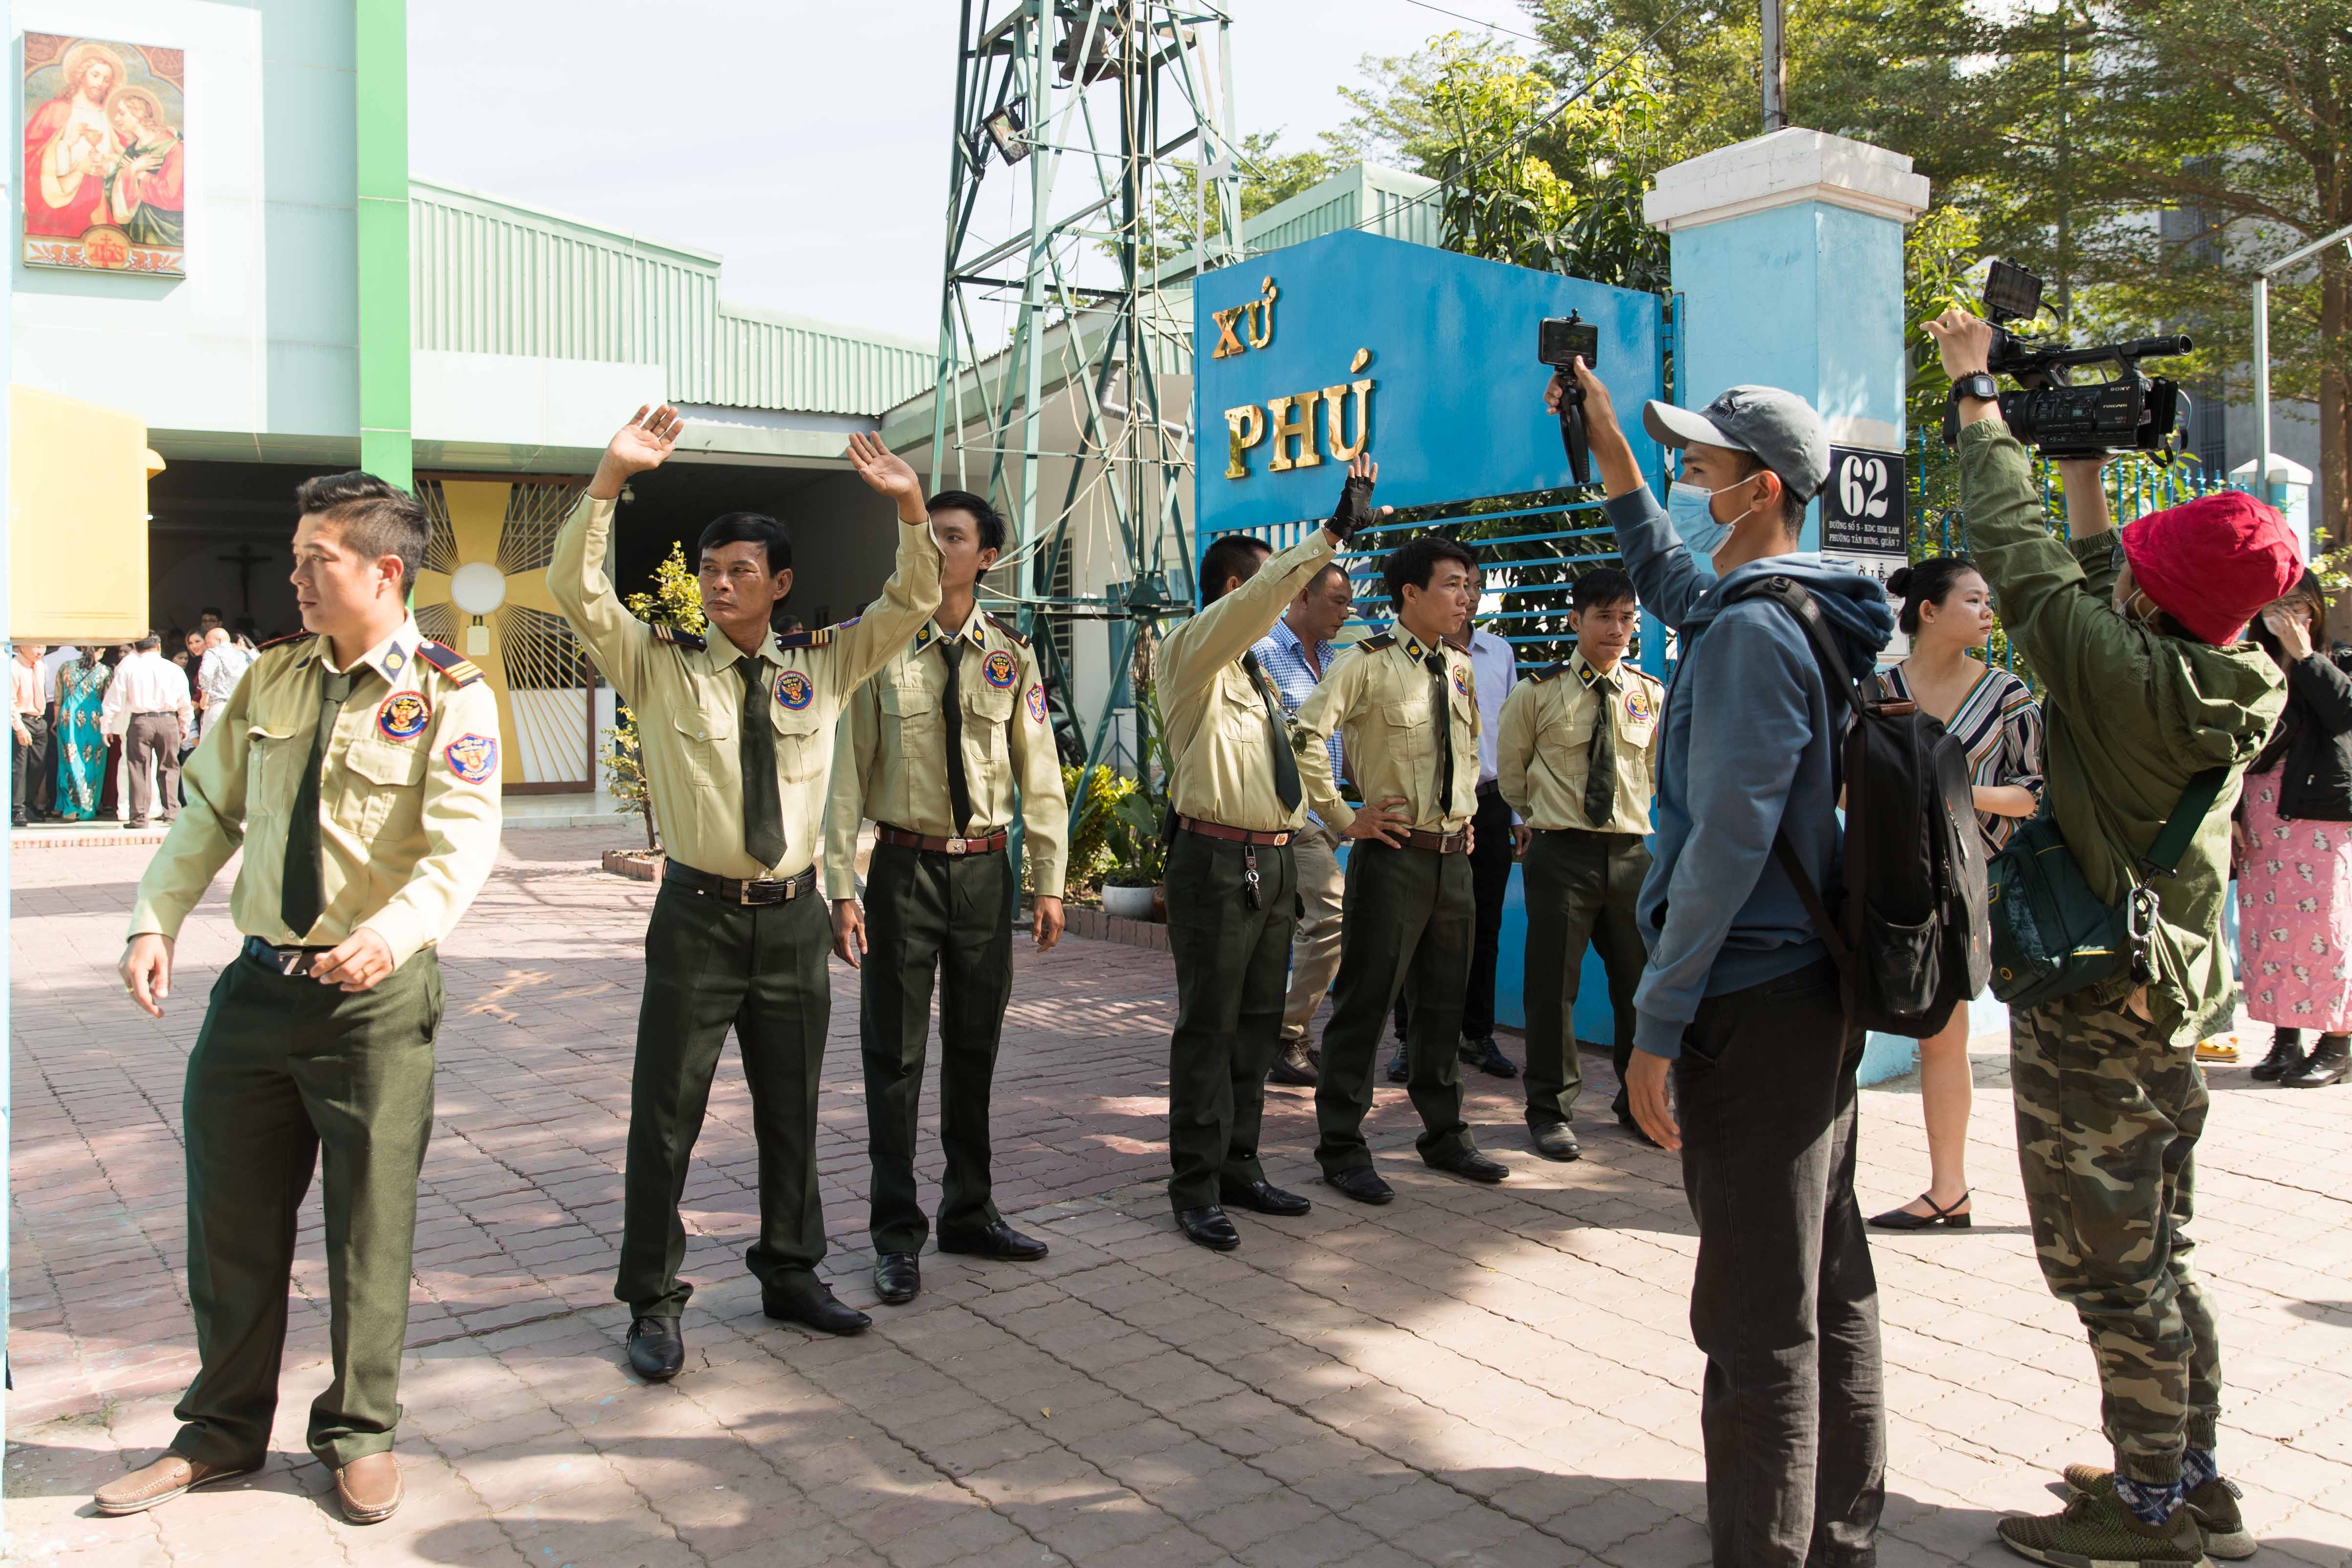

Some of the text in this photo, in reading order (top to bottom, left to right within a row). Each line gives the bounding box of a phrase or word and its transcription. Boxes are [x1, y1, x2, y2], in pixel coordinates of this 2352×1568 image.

[1212, 275, 1279, 359] XỨ
[1224, 348, 1376, 480] PHÚ
[1839, 455, 1889, 518] 62
[1829, 533, 1850, 543] PHƯỜNG
[1851, 534, 1862, 543] TÂN
[1848, 520, 1855, 531] SỐ
